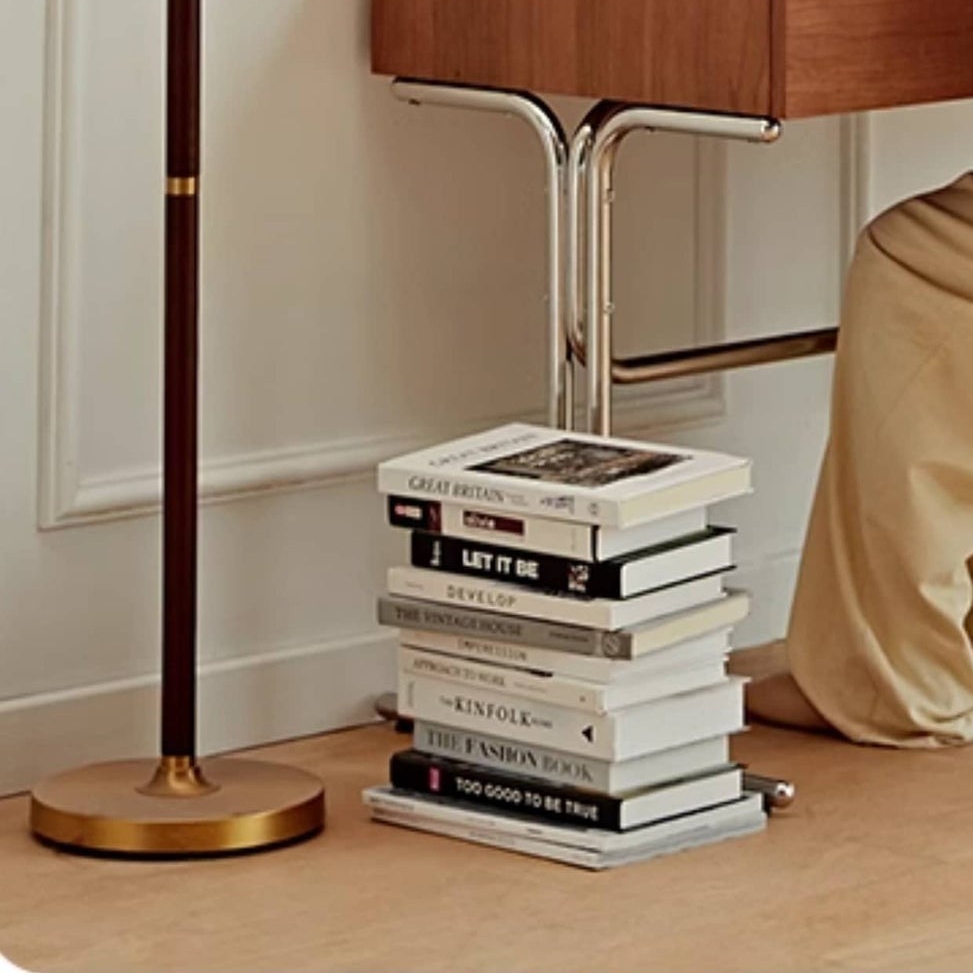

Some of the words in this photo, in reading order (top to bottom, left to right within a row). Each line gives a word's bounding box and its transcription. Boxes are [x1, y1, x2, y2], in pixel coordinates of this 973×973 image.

[408, 475, 450, 496] GREAT
[452, 483, 505, 504] BRITAIN
[462, 548, 494, 573] LET
[497, 555, 513, 576] IT
[516, 558, 540, 581] BE
[446, 584, 517, 607] DEVELOP
[395, 606, 421, 621] THE
[454, 695, 532, 727] KINFOLK
[427, 729, 462, 751] THE
[464, 734, 538, 769] FASHION
[540, 754, 595, 783] BOOK
[455, 777, 483, 795] TOO
[484, 783, 522, 804] GOOD
[524, 791, 542, 808] TO
[544, 796, 562, 813] BE
[564, 800, 599, 821] TRUE
